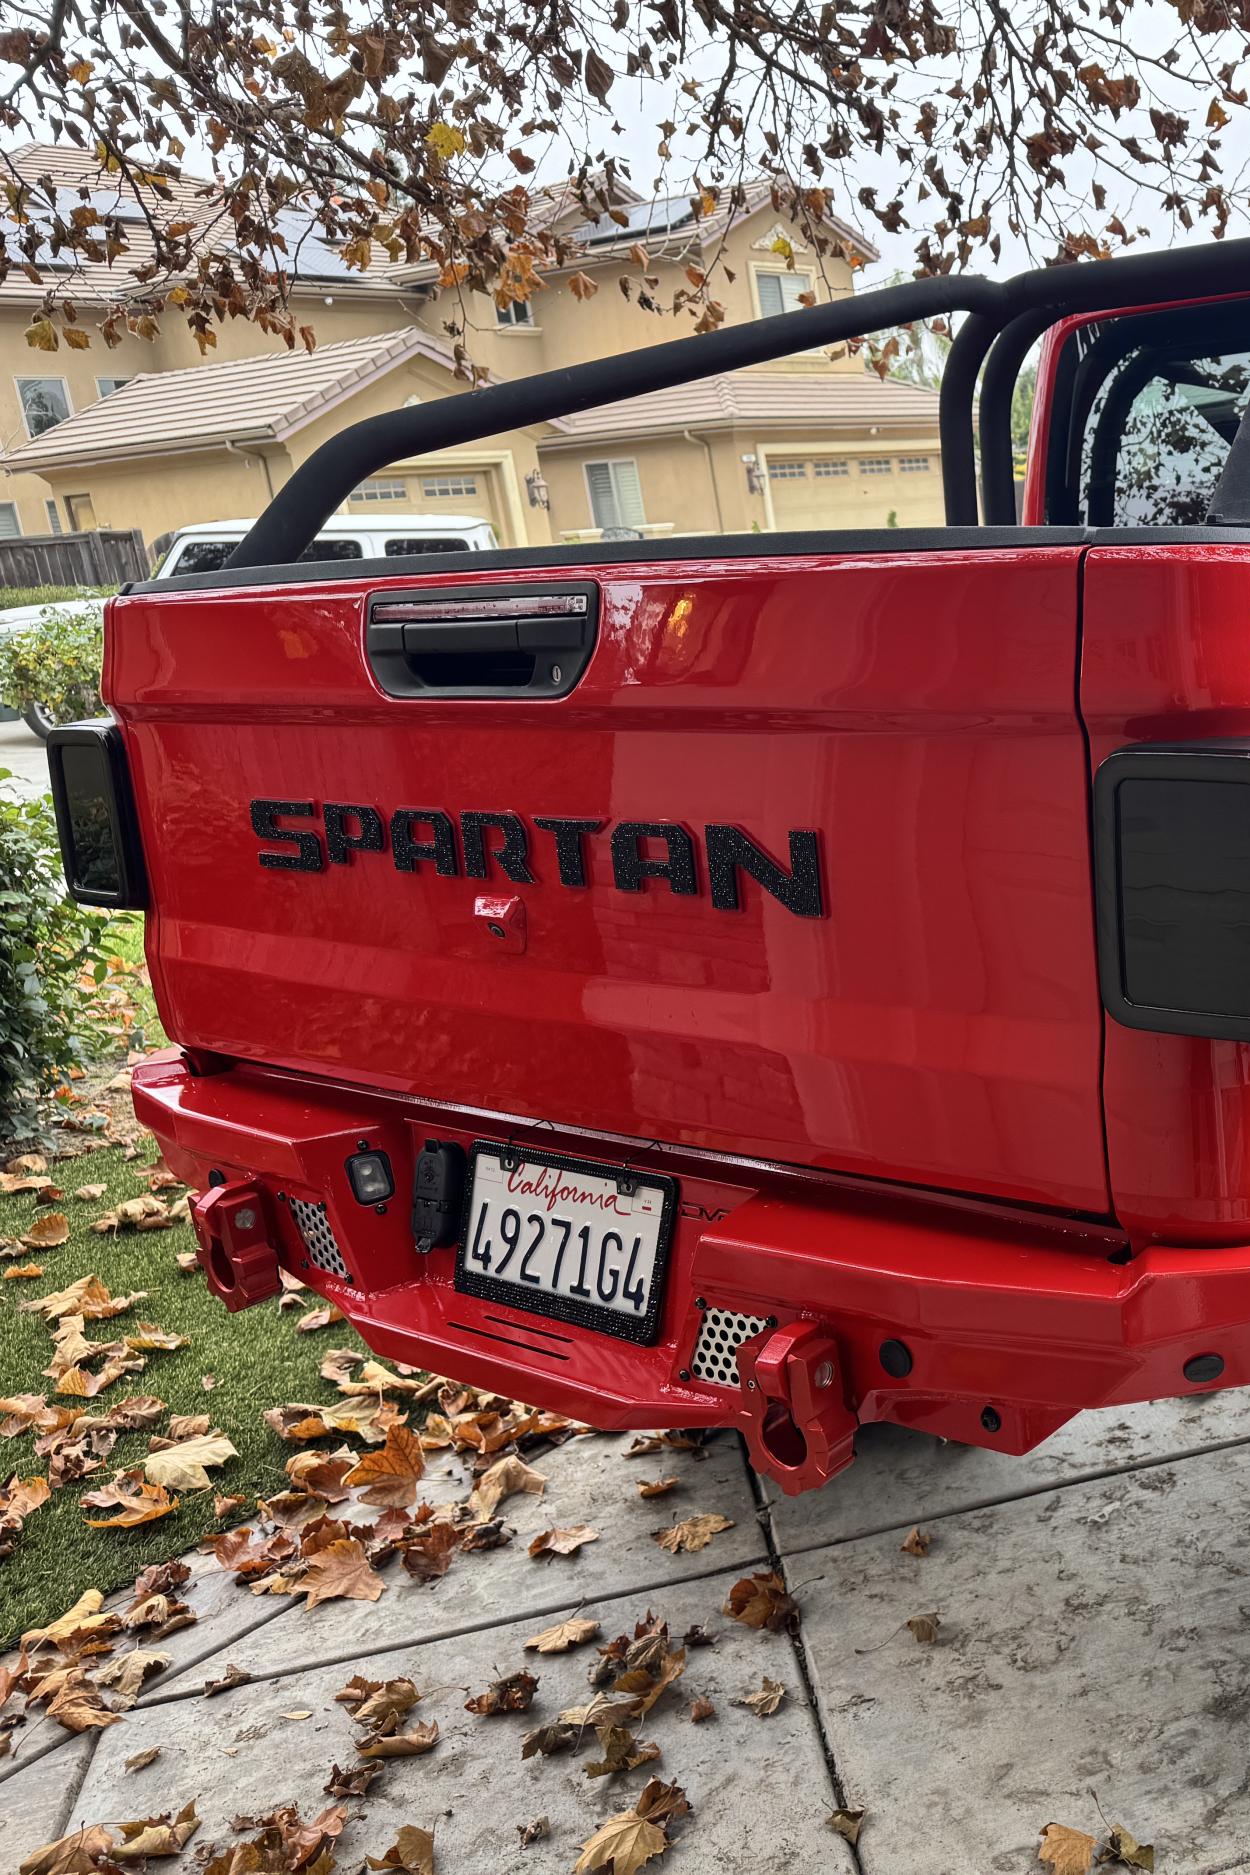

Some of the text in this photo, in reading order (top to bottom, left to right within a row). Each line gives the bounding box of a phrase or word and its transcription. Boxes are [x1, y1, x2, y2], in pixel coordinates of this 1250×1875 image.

[249, 799, 826, 919] SPARTAN
[507, 1161, 632, 1217] California
[472, 1201, 645, 1310] 49271G4
